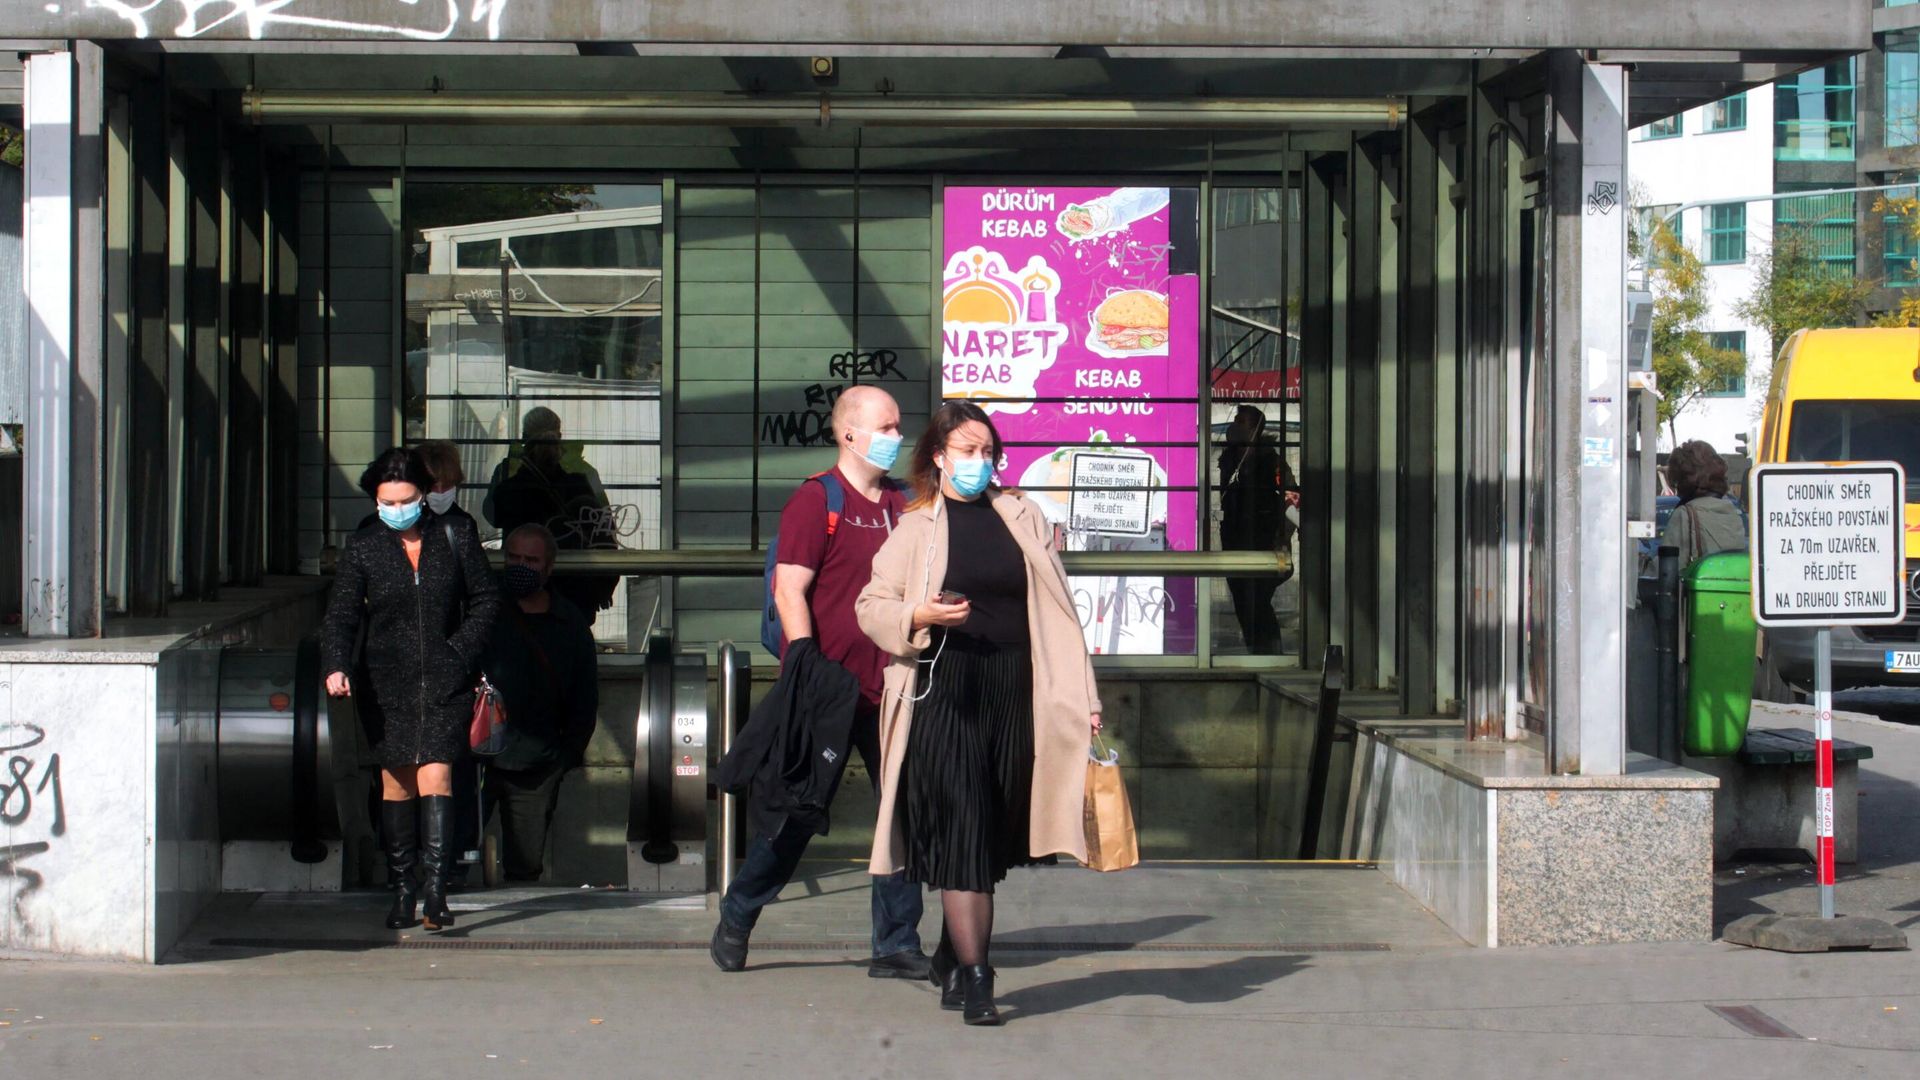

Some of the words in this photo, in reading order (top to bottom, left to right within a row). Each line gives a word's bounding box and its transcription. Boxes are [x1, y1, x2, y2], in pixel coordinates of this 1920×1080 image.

[982, 188, 1055, 212] DÜRÜM
[982, 219, 1048, 238] KEBAB
[1075, 369, 1142, 388] KEBAB
[1787, 480, 1835, 500] CHODNÍK
[1841, 480, 1872, 500] SMĚR
[1115, 520, 1139, 528] STRANU
[1769, 507, 1833, 527] PRAŽSKÉHO
[1838, 506, 1890, 527] POVSTÁNÍ
[1780, 538, 1794, 554] ZA
[1800, 538, 1823, 554] 70m
[1804, 561, 1857, 581] PŘEJDĚTE
[1775, 593, 1791, 608] NA
[1796, 591, 1839, 608] DRUHOU
[1844, 590, 1887, 607] STRANU
[677, 767, 698, 775] STOP
